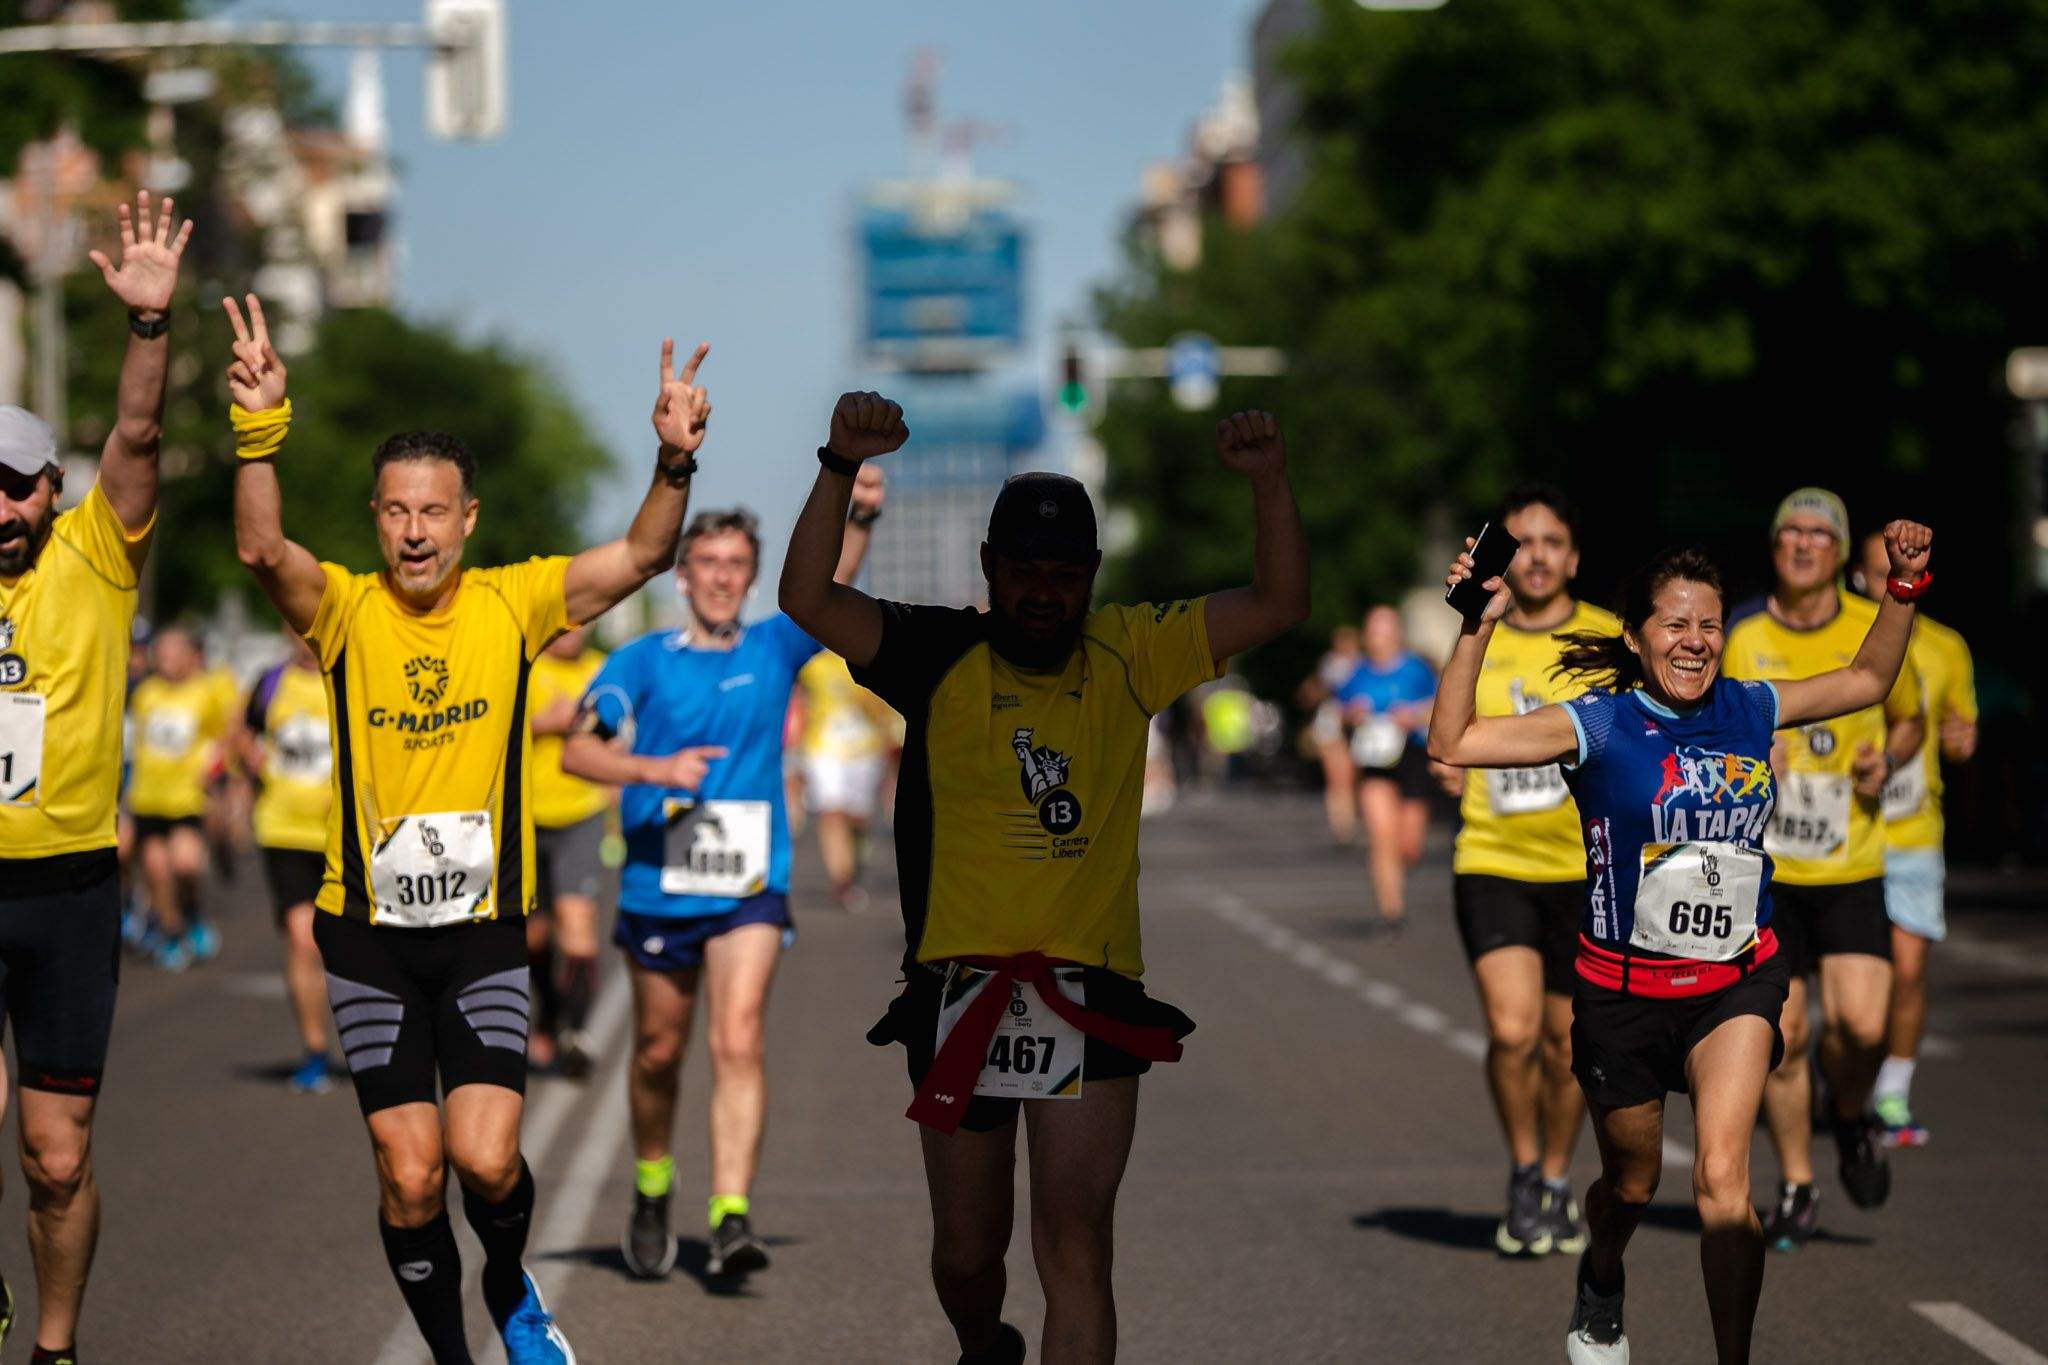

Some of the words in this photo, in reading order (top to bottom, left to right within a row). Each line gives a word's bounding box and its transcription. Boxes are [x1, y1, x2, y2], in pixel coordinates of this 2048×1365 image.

[1048, 800, 1072, 824] 13
[1651, 803, 1689, 844] LA
[1052, 837, 1089, 848] Carrera
[396, 871, 468, 906] 3012
[1709, 873, 1719, 884] 13
[1668, 900, 1733, 939] 695
[1013, 1002, 1024, 1012] 13
[981, 1035, 1056, 1075] 467
